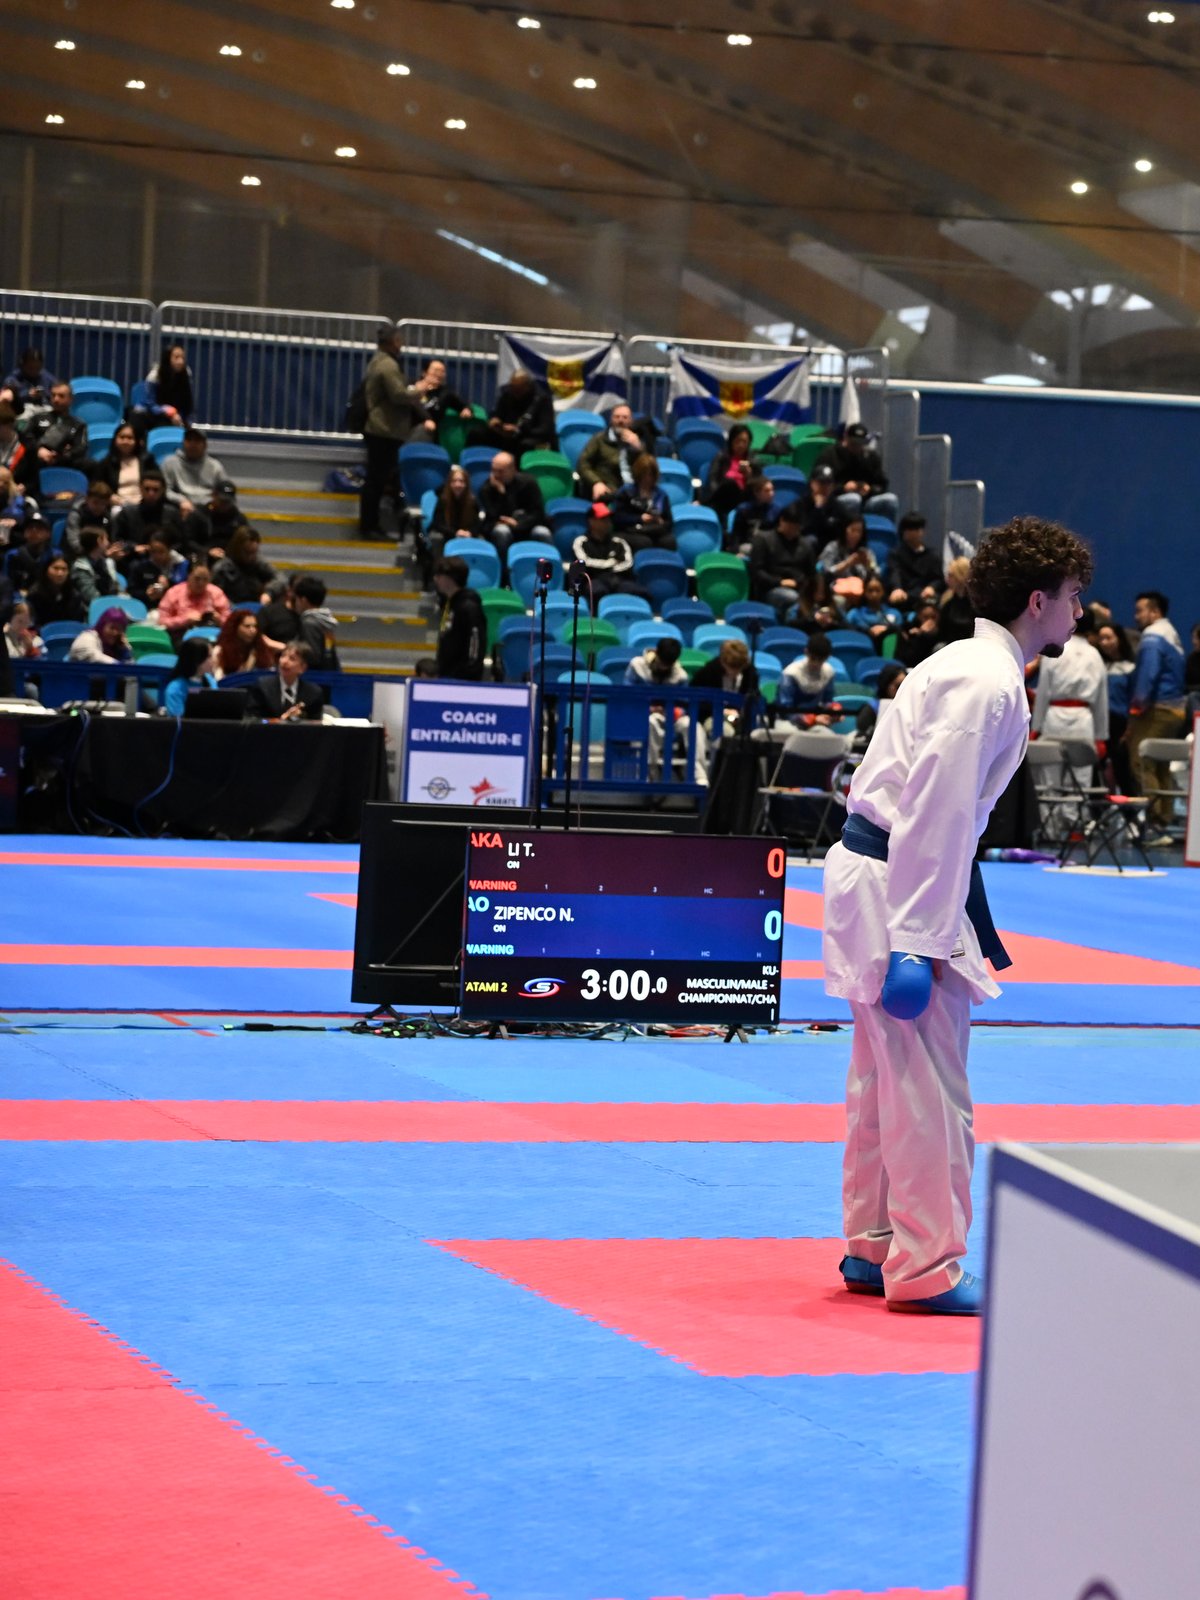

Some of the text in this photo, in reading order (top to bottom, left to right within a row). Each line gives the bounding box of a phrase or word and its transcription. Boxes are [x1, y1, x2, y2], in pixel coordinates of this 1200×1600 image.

[442, 710, 497, 725] COACH
[508, 842, 536, 857] LI T.
[506, 861, 520, 869] ON
[767, 848, 785, 878] 0
[469, 880, 517, 891] WARNING
[493, 906, 575, 922] ZIPENCO N.
[492, 924, 507, 933] ON
[764, 910, 782, 941] 0
[762, 965, 779, 976] KU-
[465, 982, 508, 993] ATAMI 2
[686, 979, 768, 990] MASCULIN/MALE
[678, 992, 777, 1005] CHAMPIONNAT/CHA
